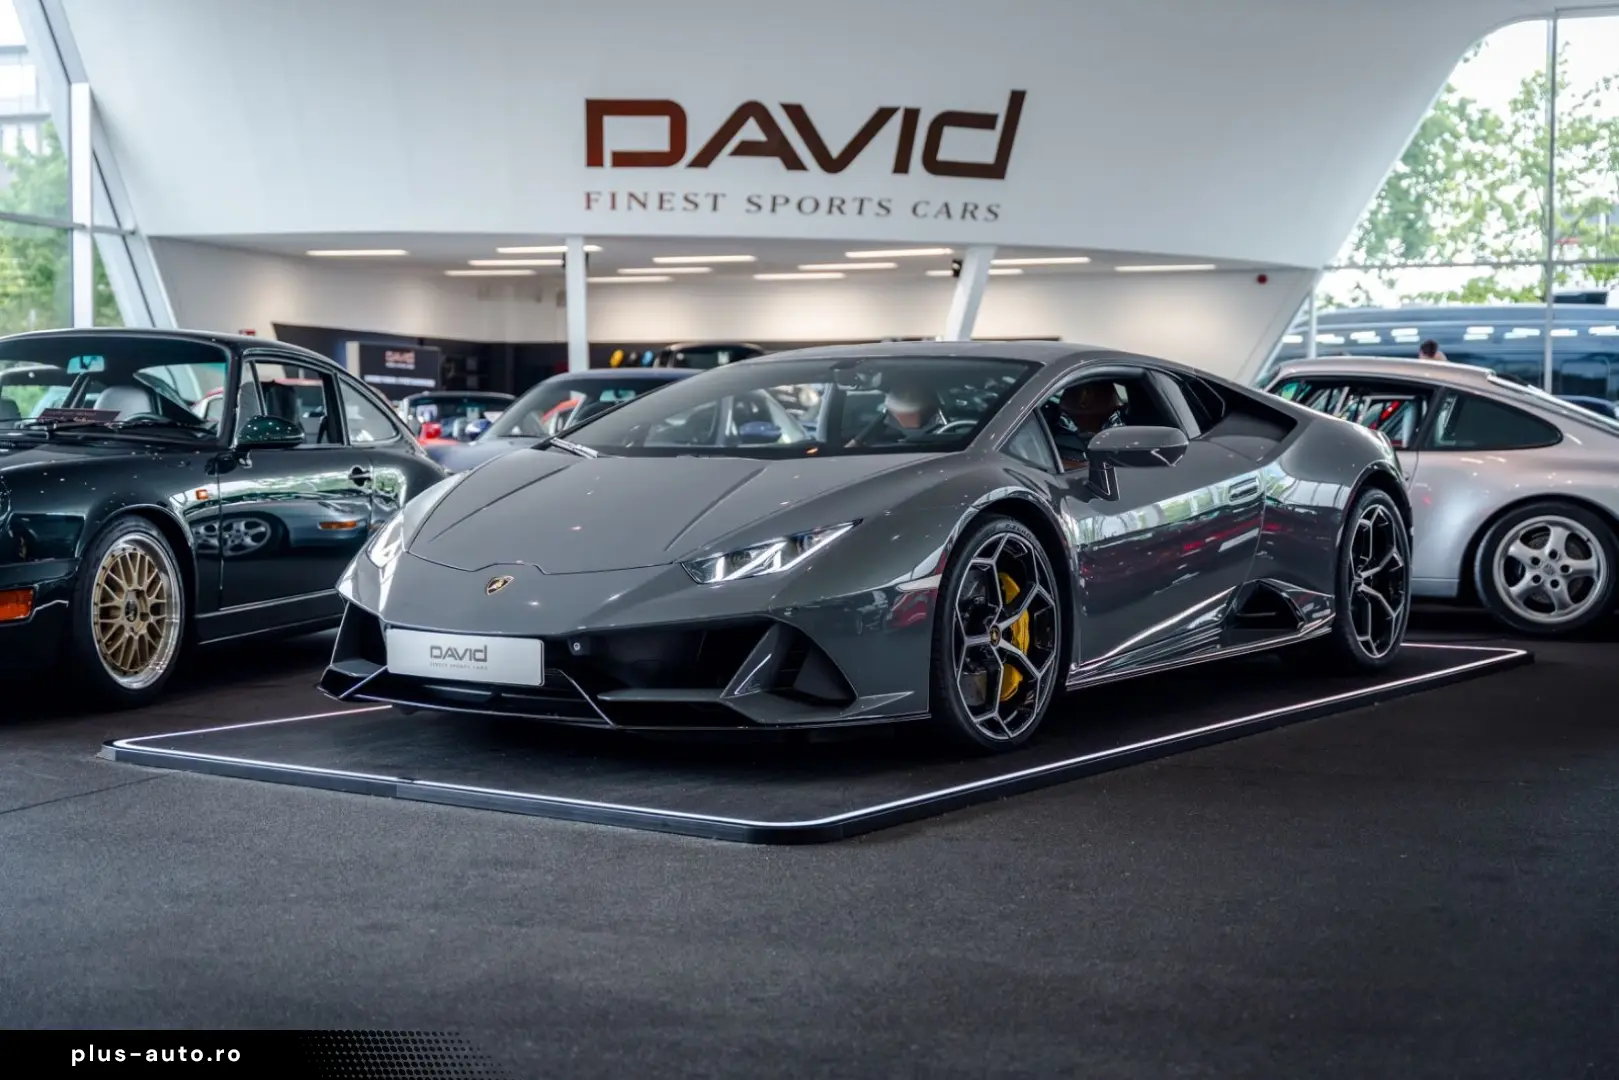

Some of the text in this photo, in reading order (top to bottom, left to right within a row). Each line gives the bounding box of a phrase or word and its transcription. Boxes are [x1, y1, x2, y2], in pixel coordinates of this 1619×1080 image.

[584, 191, 1001, 222] FINEST SPORTS CARS
